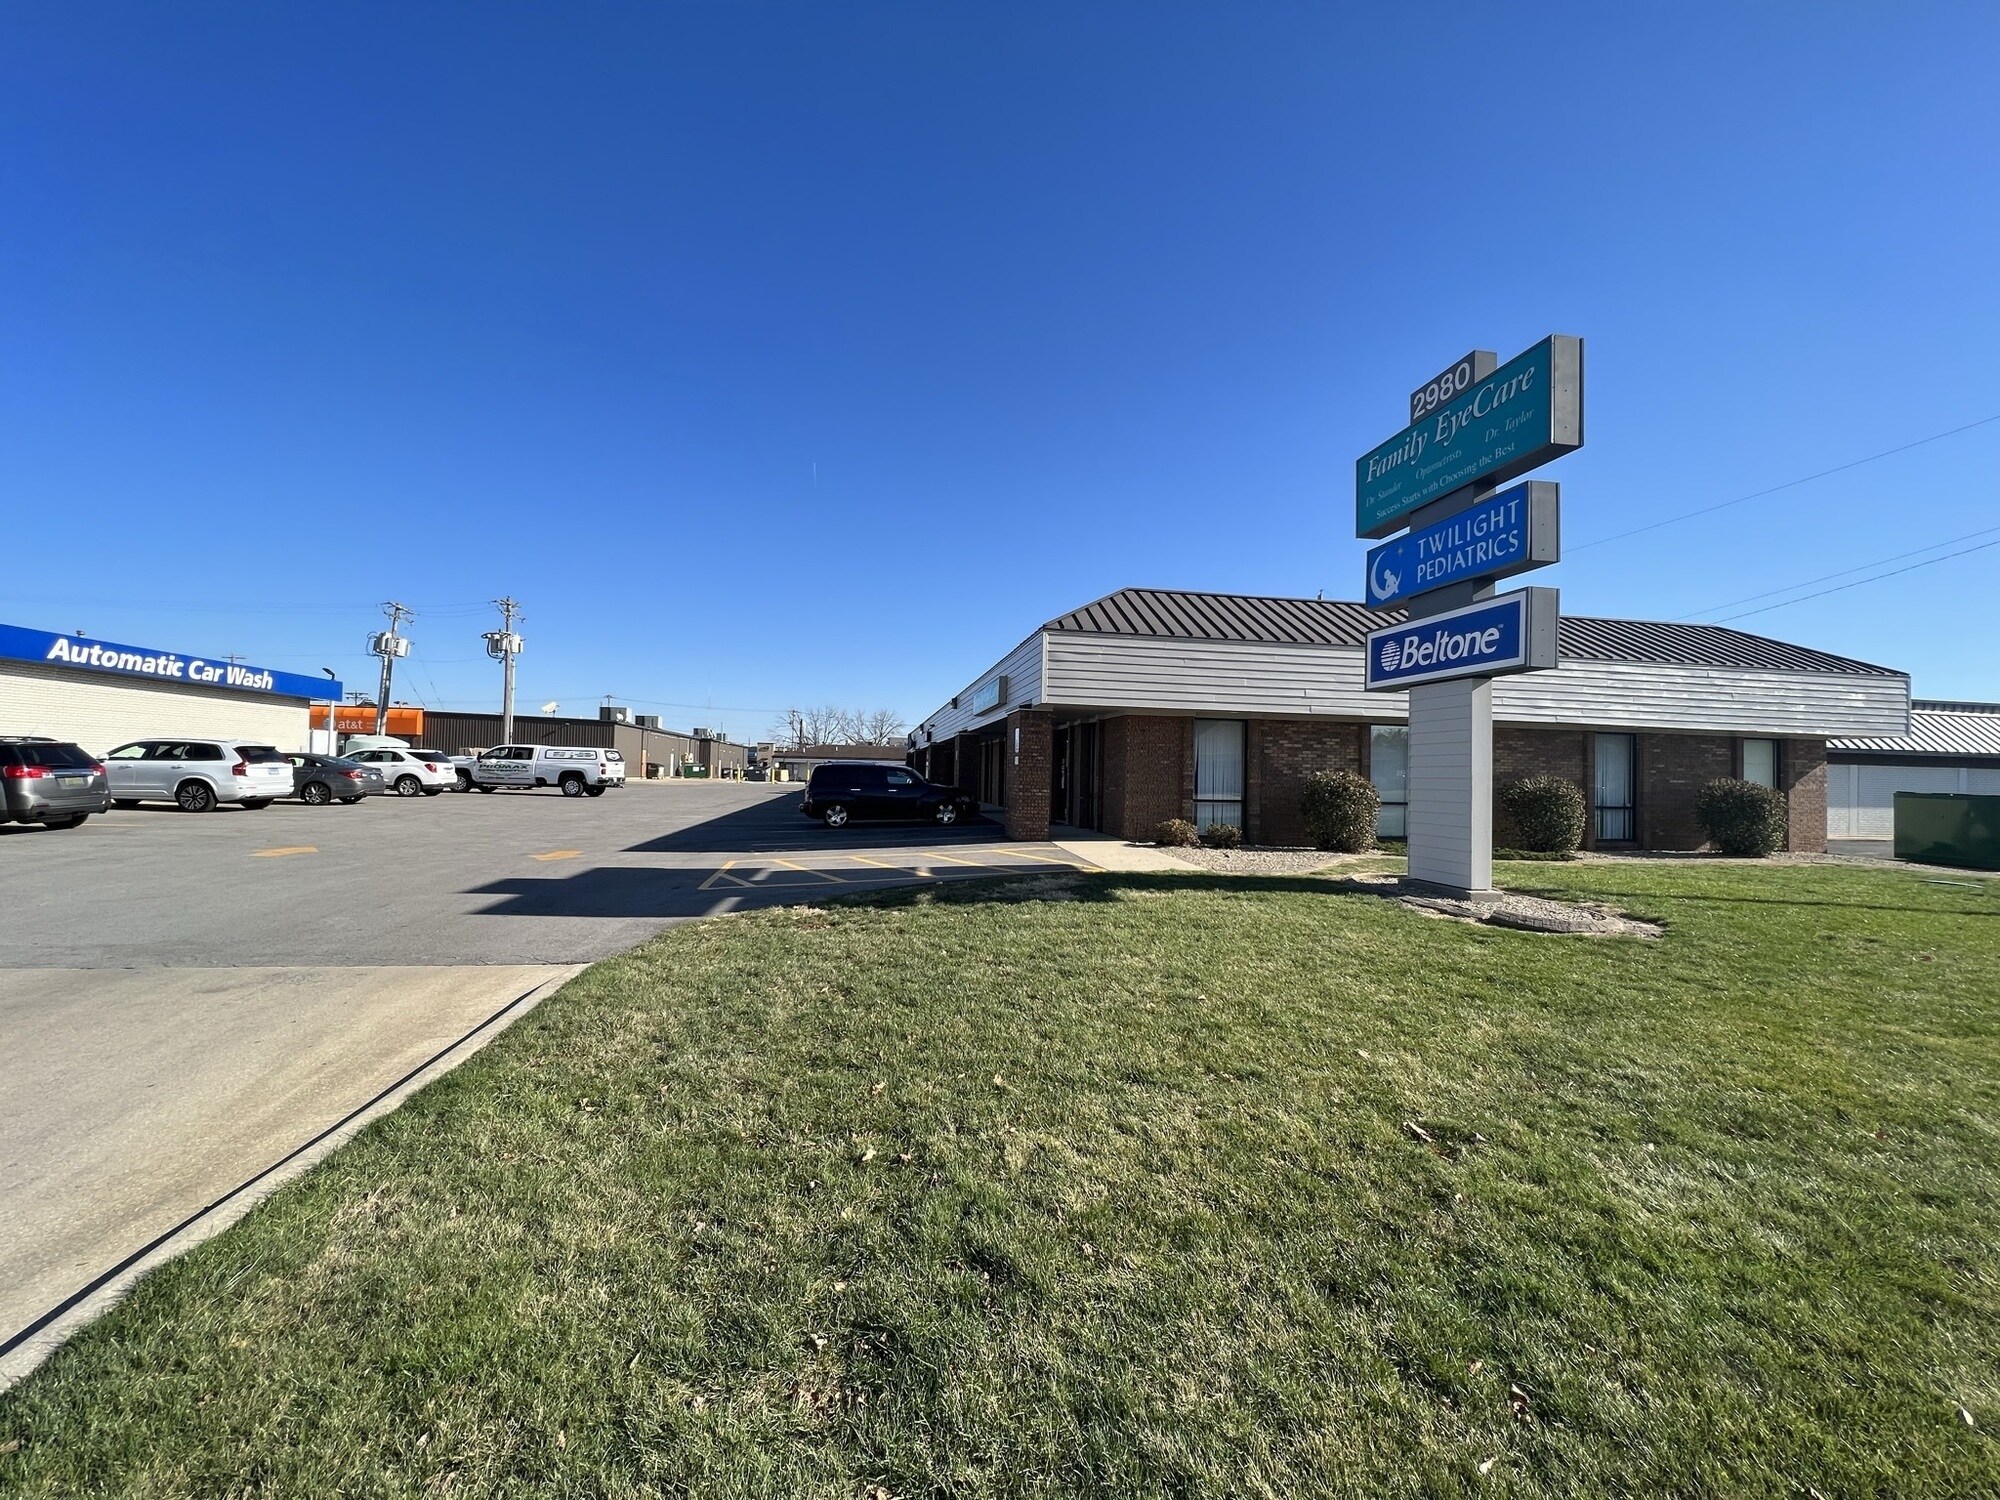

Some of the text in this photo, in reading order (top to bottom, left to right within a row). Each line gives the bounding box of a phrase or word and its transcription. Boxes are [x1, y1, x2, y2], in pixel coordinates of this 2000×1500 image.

[1412, 362, 1471, 420] 2980
[1365, 366, 1535, 484] Family EyeCare
[1484, 409, 1535, 443] Dr. Taylor
[1376, 442, 1516, 520] Success Starts with Choosing the Best
[1415, 449, 1462, 481] Optometrists
[1417, 499, 1520, 559] TWILIGHT
[1416, 529, 1519, 584] PEDIATRICS
[47, 638, 274, 690] Automatic Car Wash
[1400, 627, 1500, 670] Beltone
[337, 719, 363, 729] at&t
